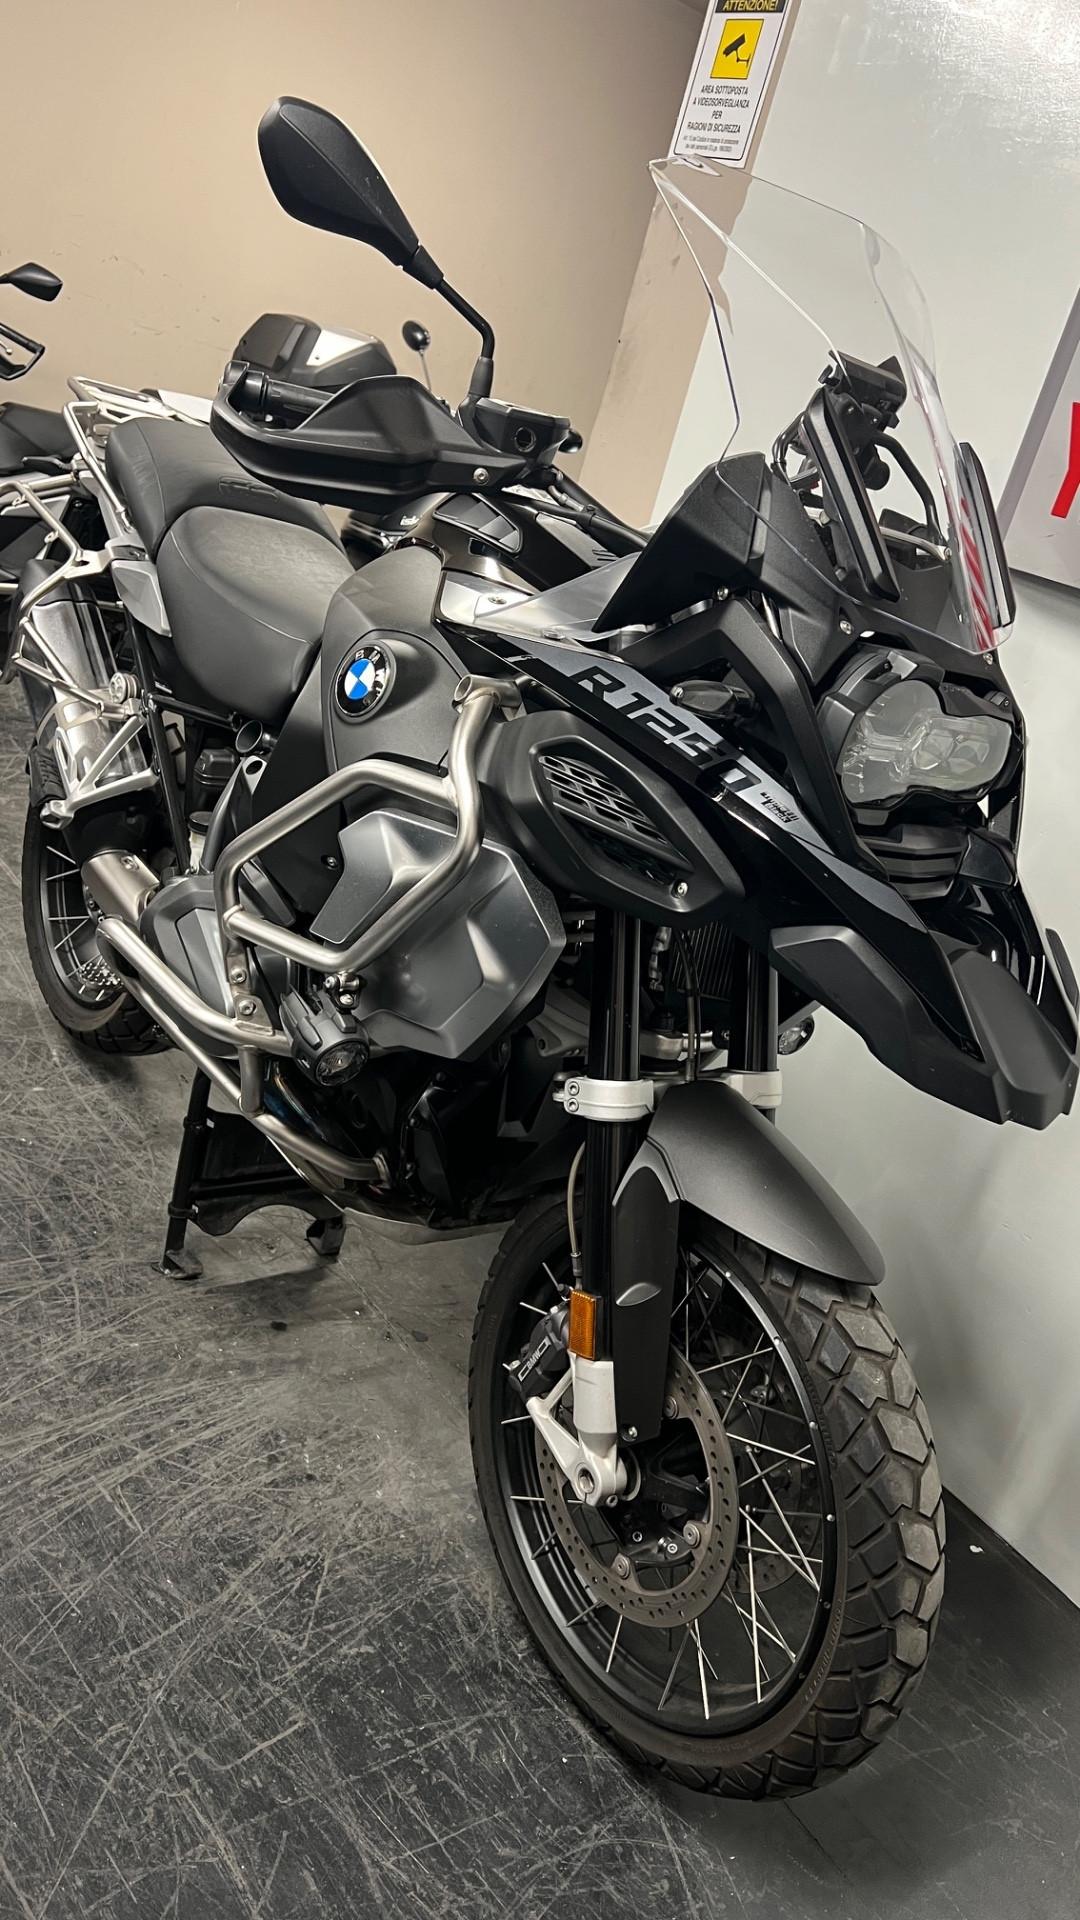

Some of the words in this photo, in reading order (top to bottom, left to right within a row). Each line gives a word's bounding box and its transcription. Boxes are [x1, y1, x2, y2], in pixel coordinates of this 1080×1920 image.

[722, 0, 778, 11] ATTENZIONE!
[701, 85, 713, 94] AREA
[715, 85, 748, 95] SOTTOPOSTA
[697, 97, 749, 108] VIDEOSORVEGLIANZA
[711, 110, 723, 119] PER
[687, 121, 706, 131] RAGIONI
[713, 123, 741, 133] SICUREZZA
